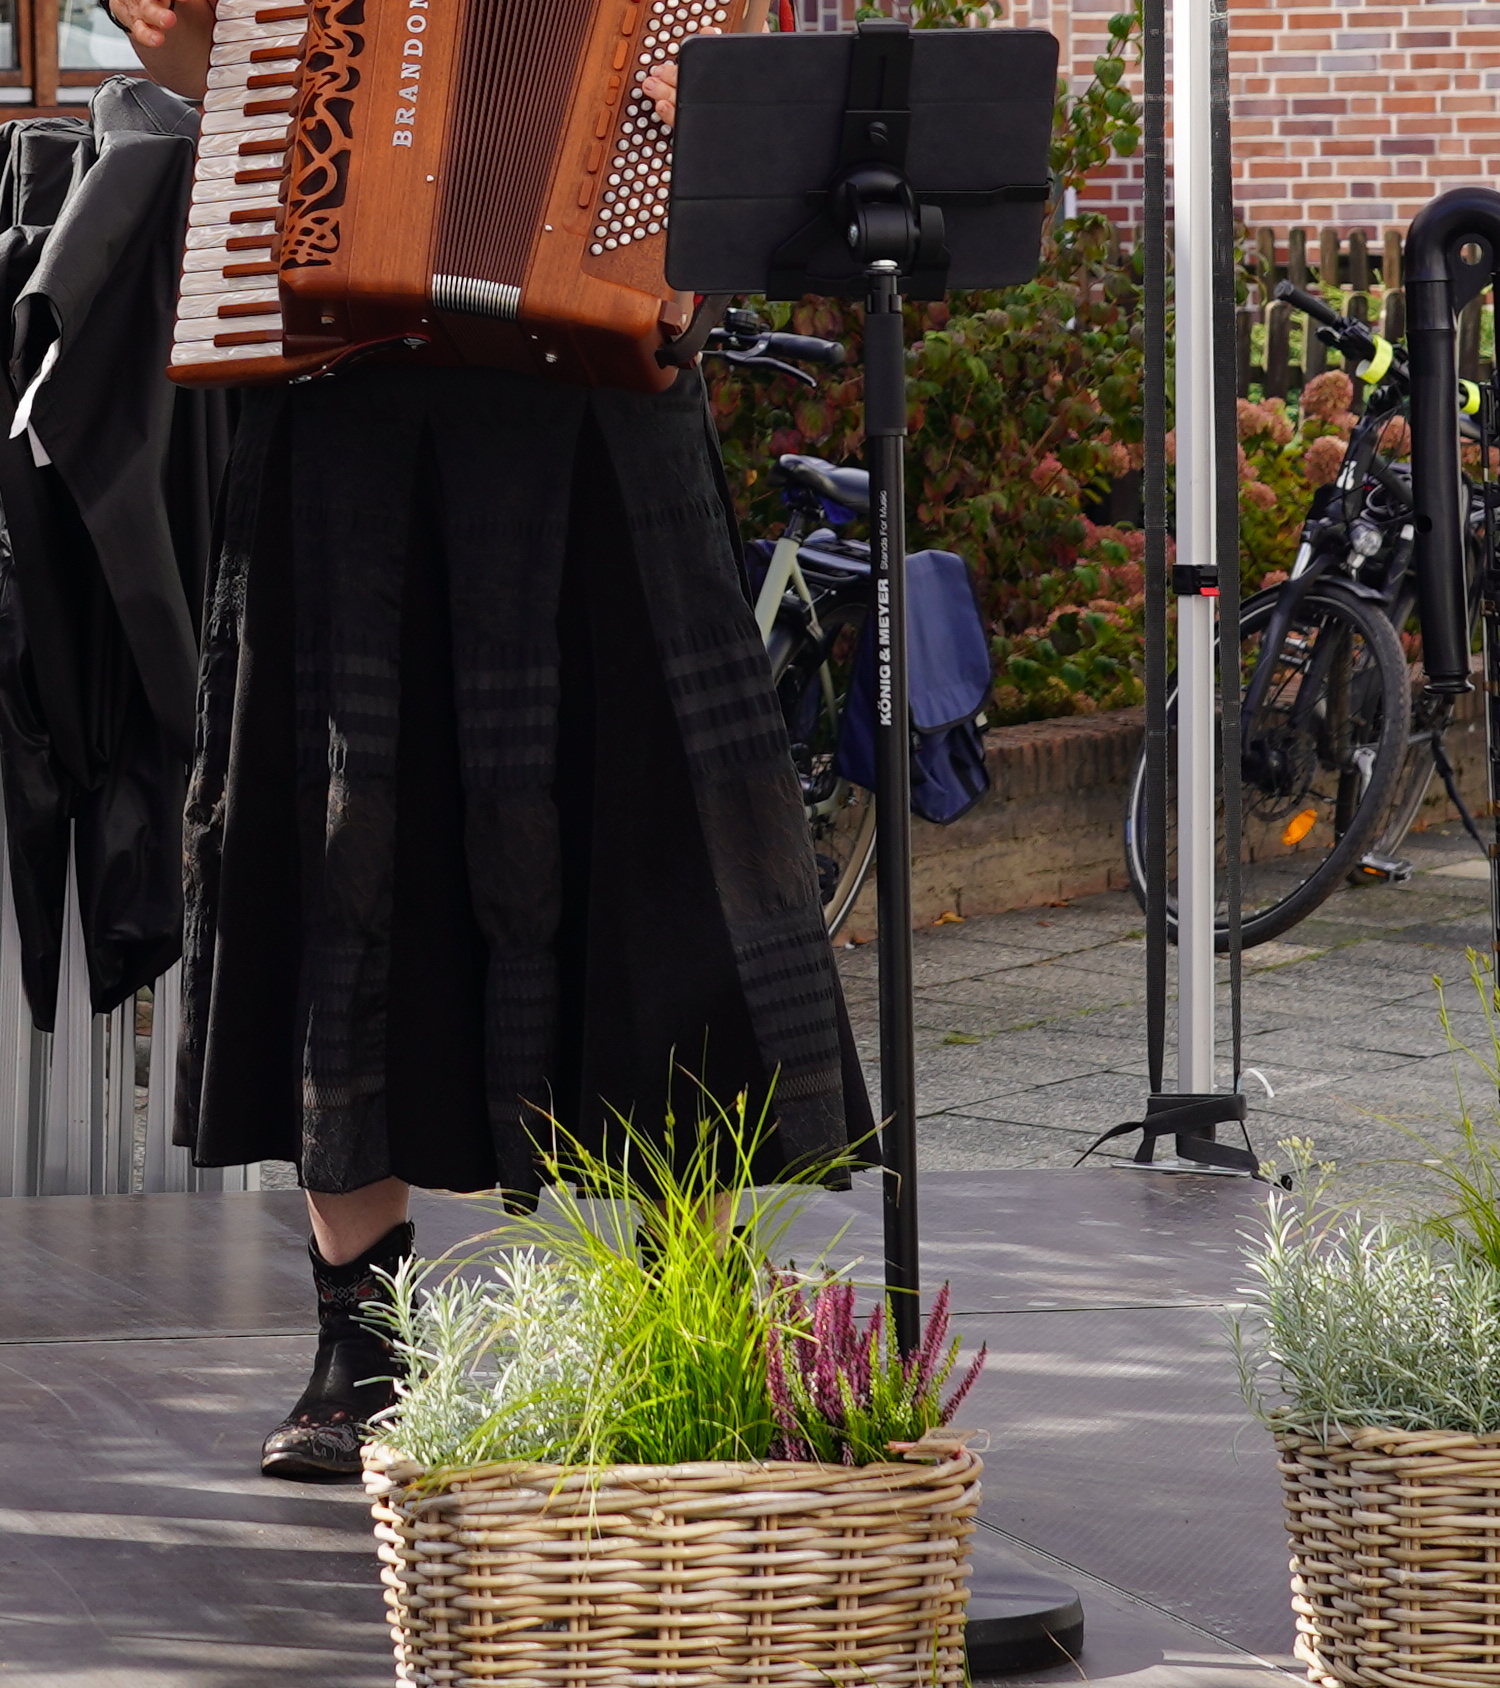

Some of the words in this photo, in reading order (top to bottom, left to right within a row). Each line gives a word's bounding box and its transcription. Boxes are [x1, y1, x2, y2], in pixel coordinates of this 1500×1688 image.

[877, 578, 890, 646] MEYER
[879, 647, 891, 663] &
[877, 664, 892, 726] KÖNIG
